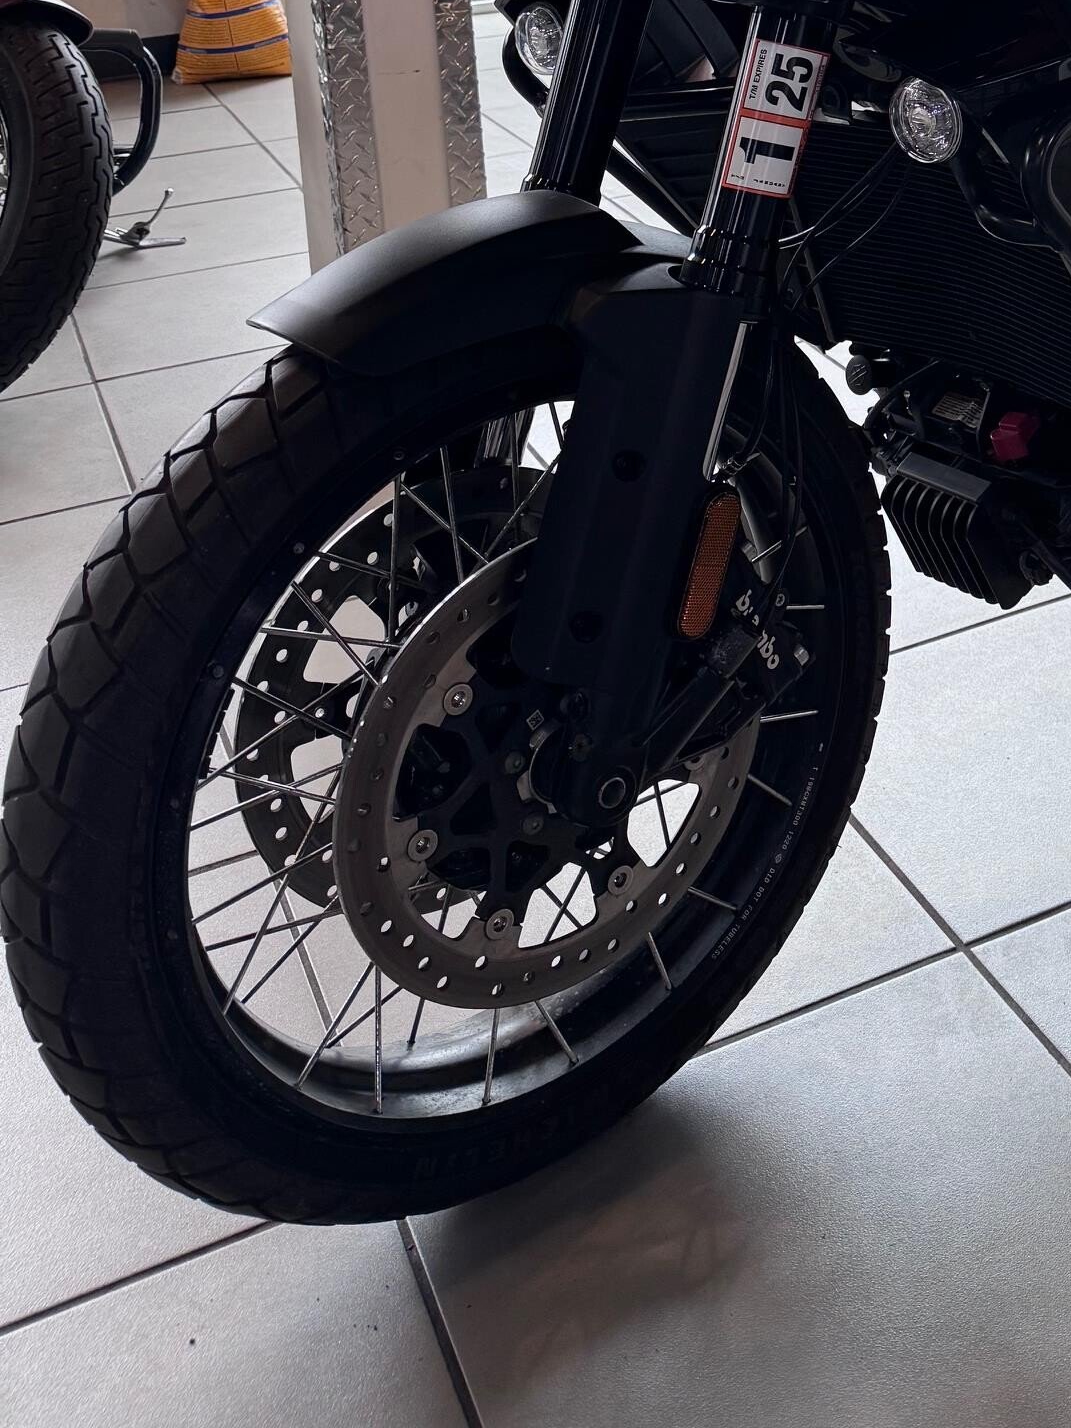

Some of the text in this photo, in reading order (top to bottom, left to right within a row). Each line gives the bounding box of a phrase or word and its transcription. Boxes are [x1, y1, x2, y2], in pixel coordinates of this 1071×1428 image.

[754, 49, 768, 83] EXPIRES
[765, 53, 814, 112] 25
[739, 137, 796, 164] 1
[753, 886, 765, 903] DOT
[711, 923, 741, 960] TUBELESS
